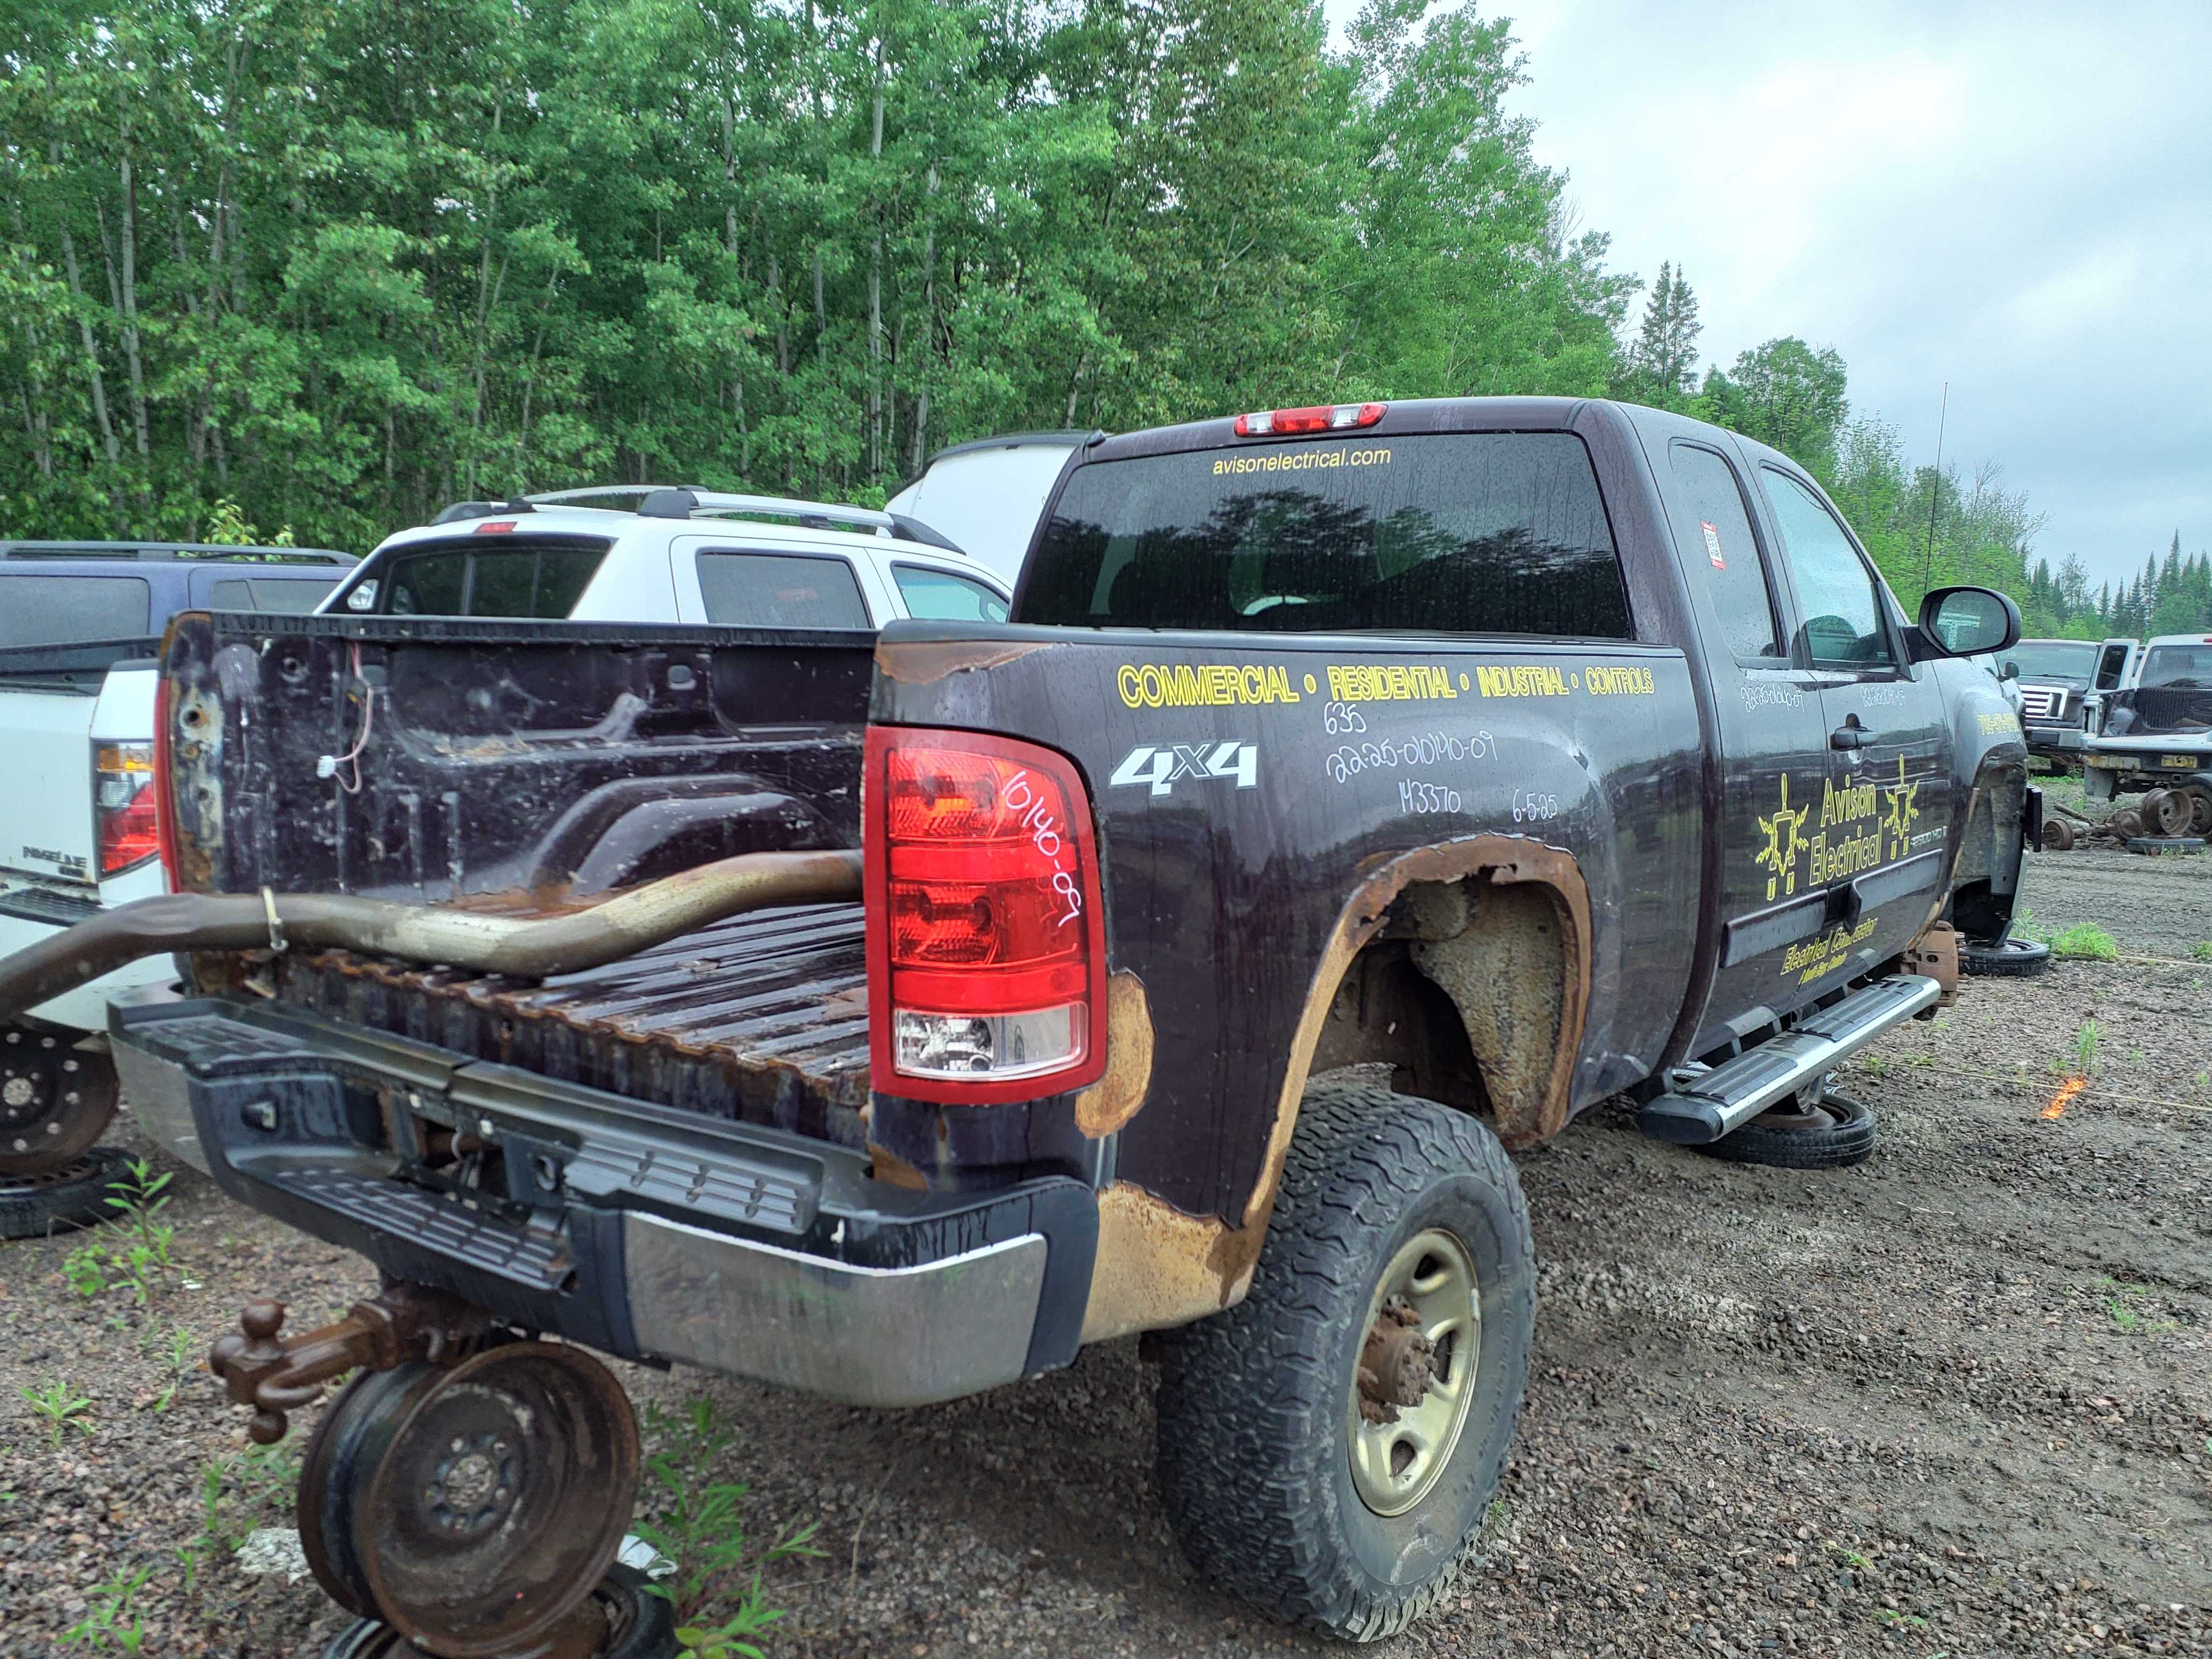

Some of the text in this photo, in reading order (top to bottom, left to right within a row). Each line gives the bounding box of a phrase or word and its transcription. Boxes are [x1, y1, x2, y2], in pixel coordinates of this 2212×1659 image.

[1213, 448, 1391, 475] avisonelectrical.com
[1117, 664, 1655, 708] COMMERCIAL RESIDENTIAL INDUSTRIAL CONTROLS
[1324, 701, 1366, 735] 635
[1820, 774, 1877, 828] Avison
[1809, 817, 1882, 886] Electrical
[1780, 930, 1833, 975] Electrical
